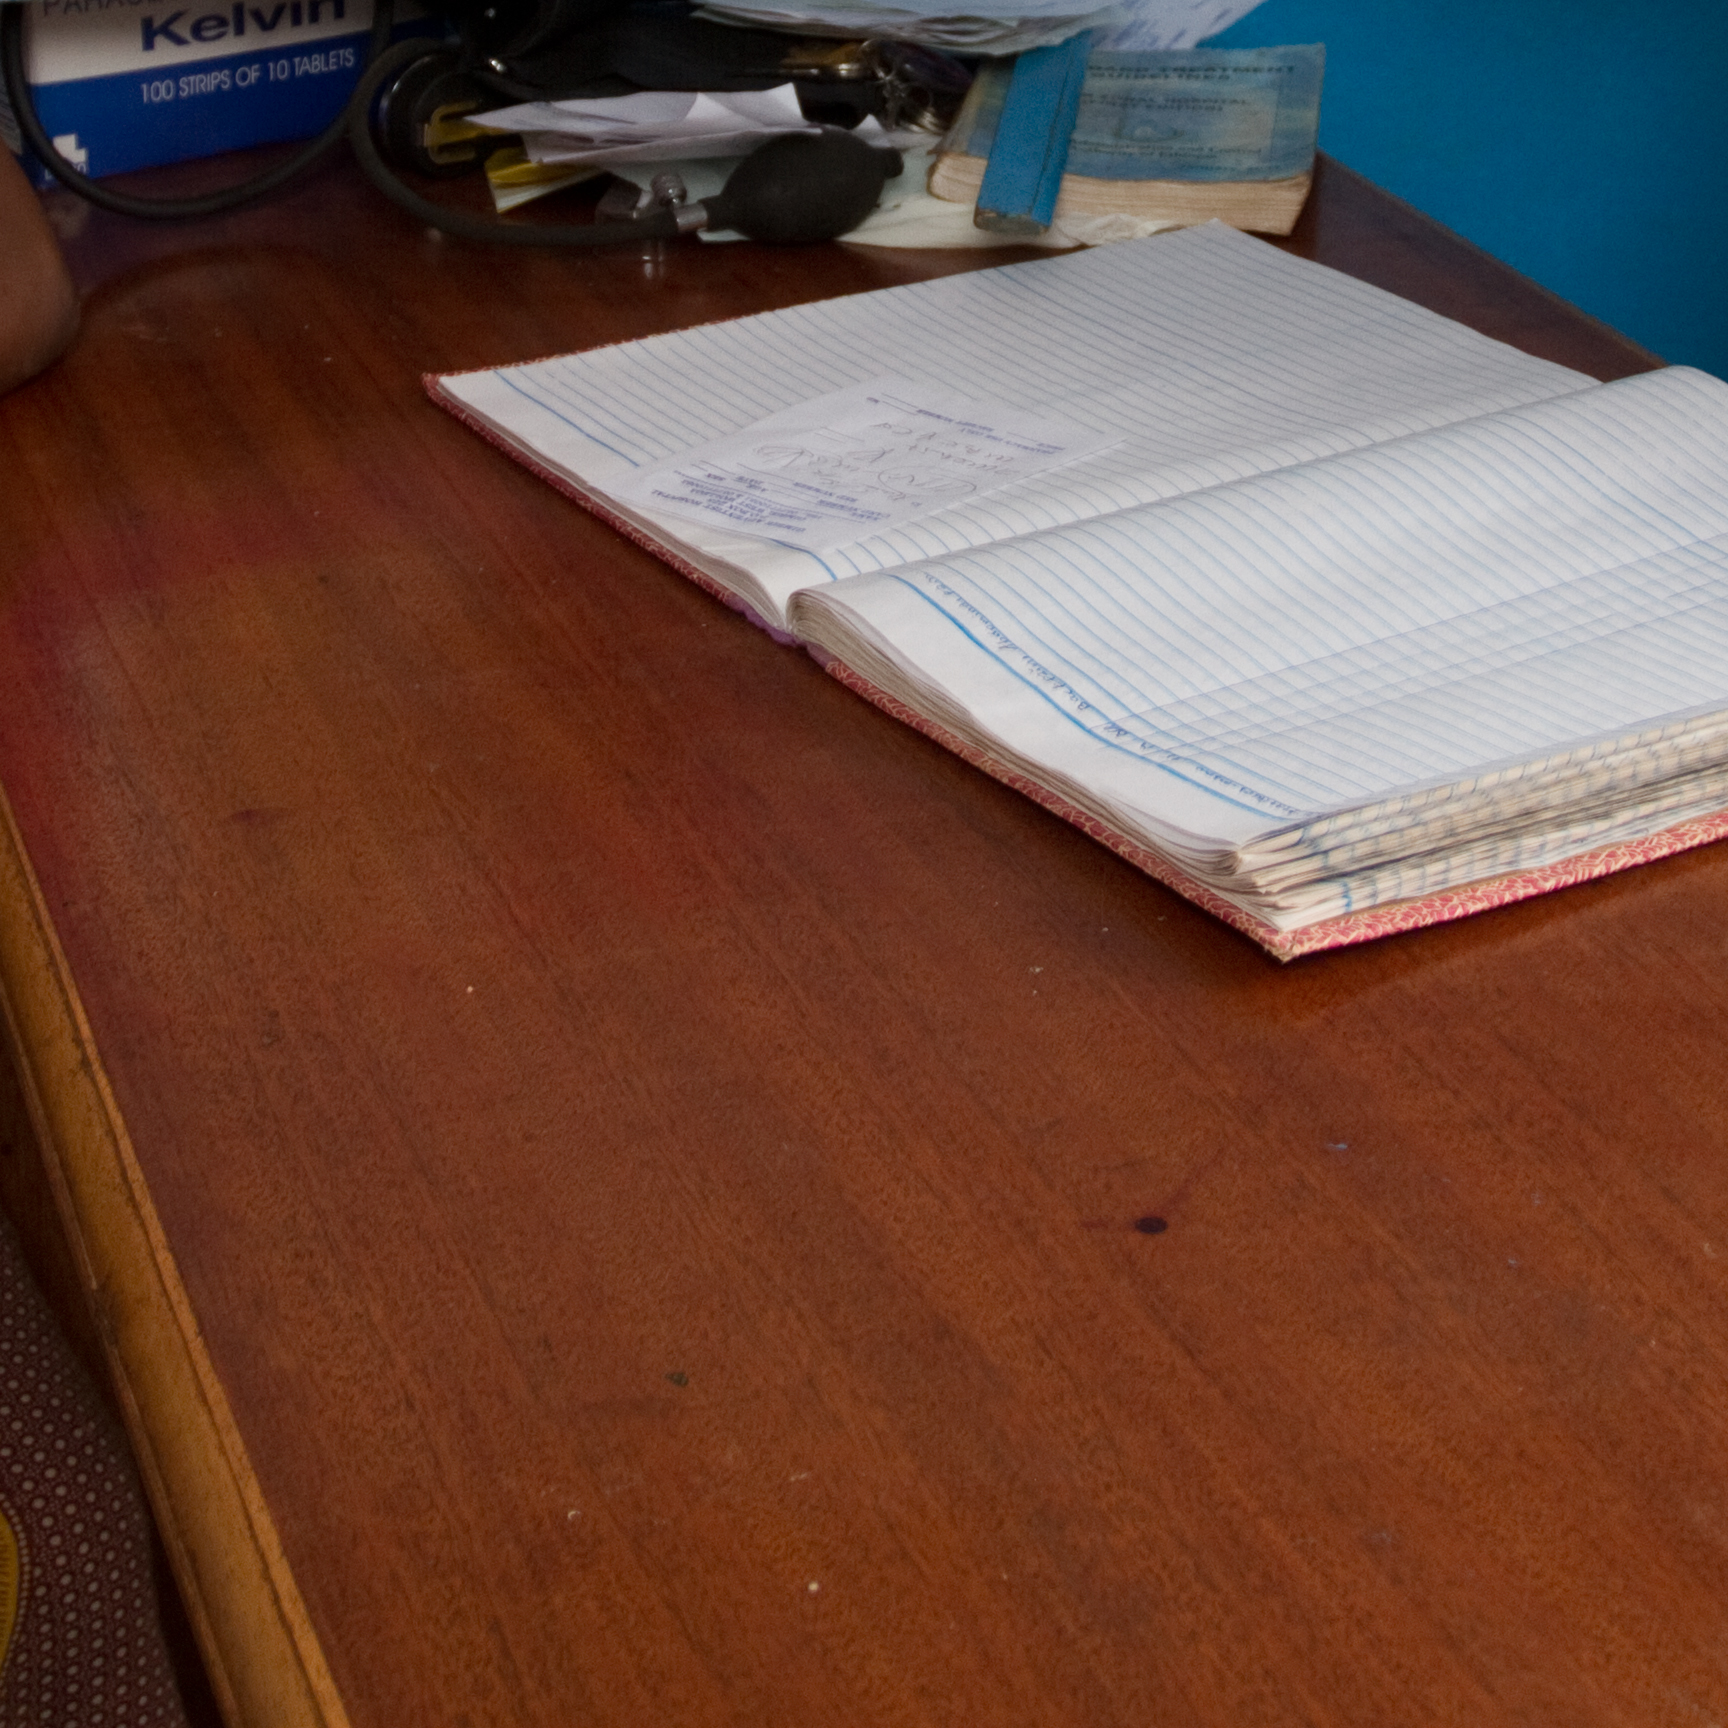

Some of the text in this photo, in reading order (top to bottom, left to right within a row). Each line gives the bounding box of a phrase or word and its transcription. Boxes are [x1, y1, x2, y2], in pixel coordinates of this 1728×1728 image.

[141, 47, 355, 104] 100 STRIPS OF 10 TABLETS
